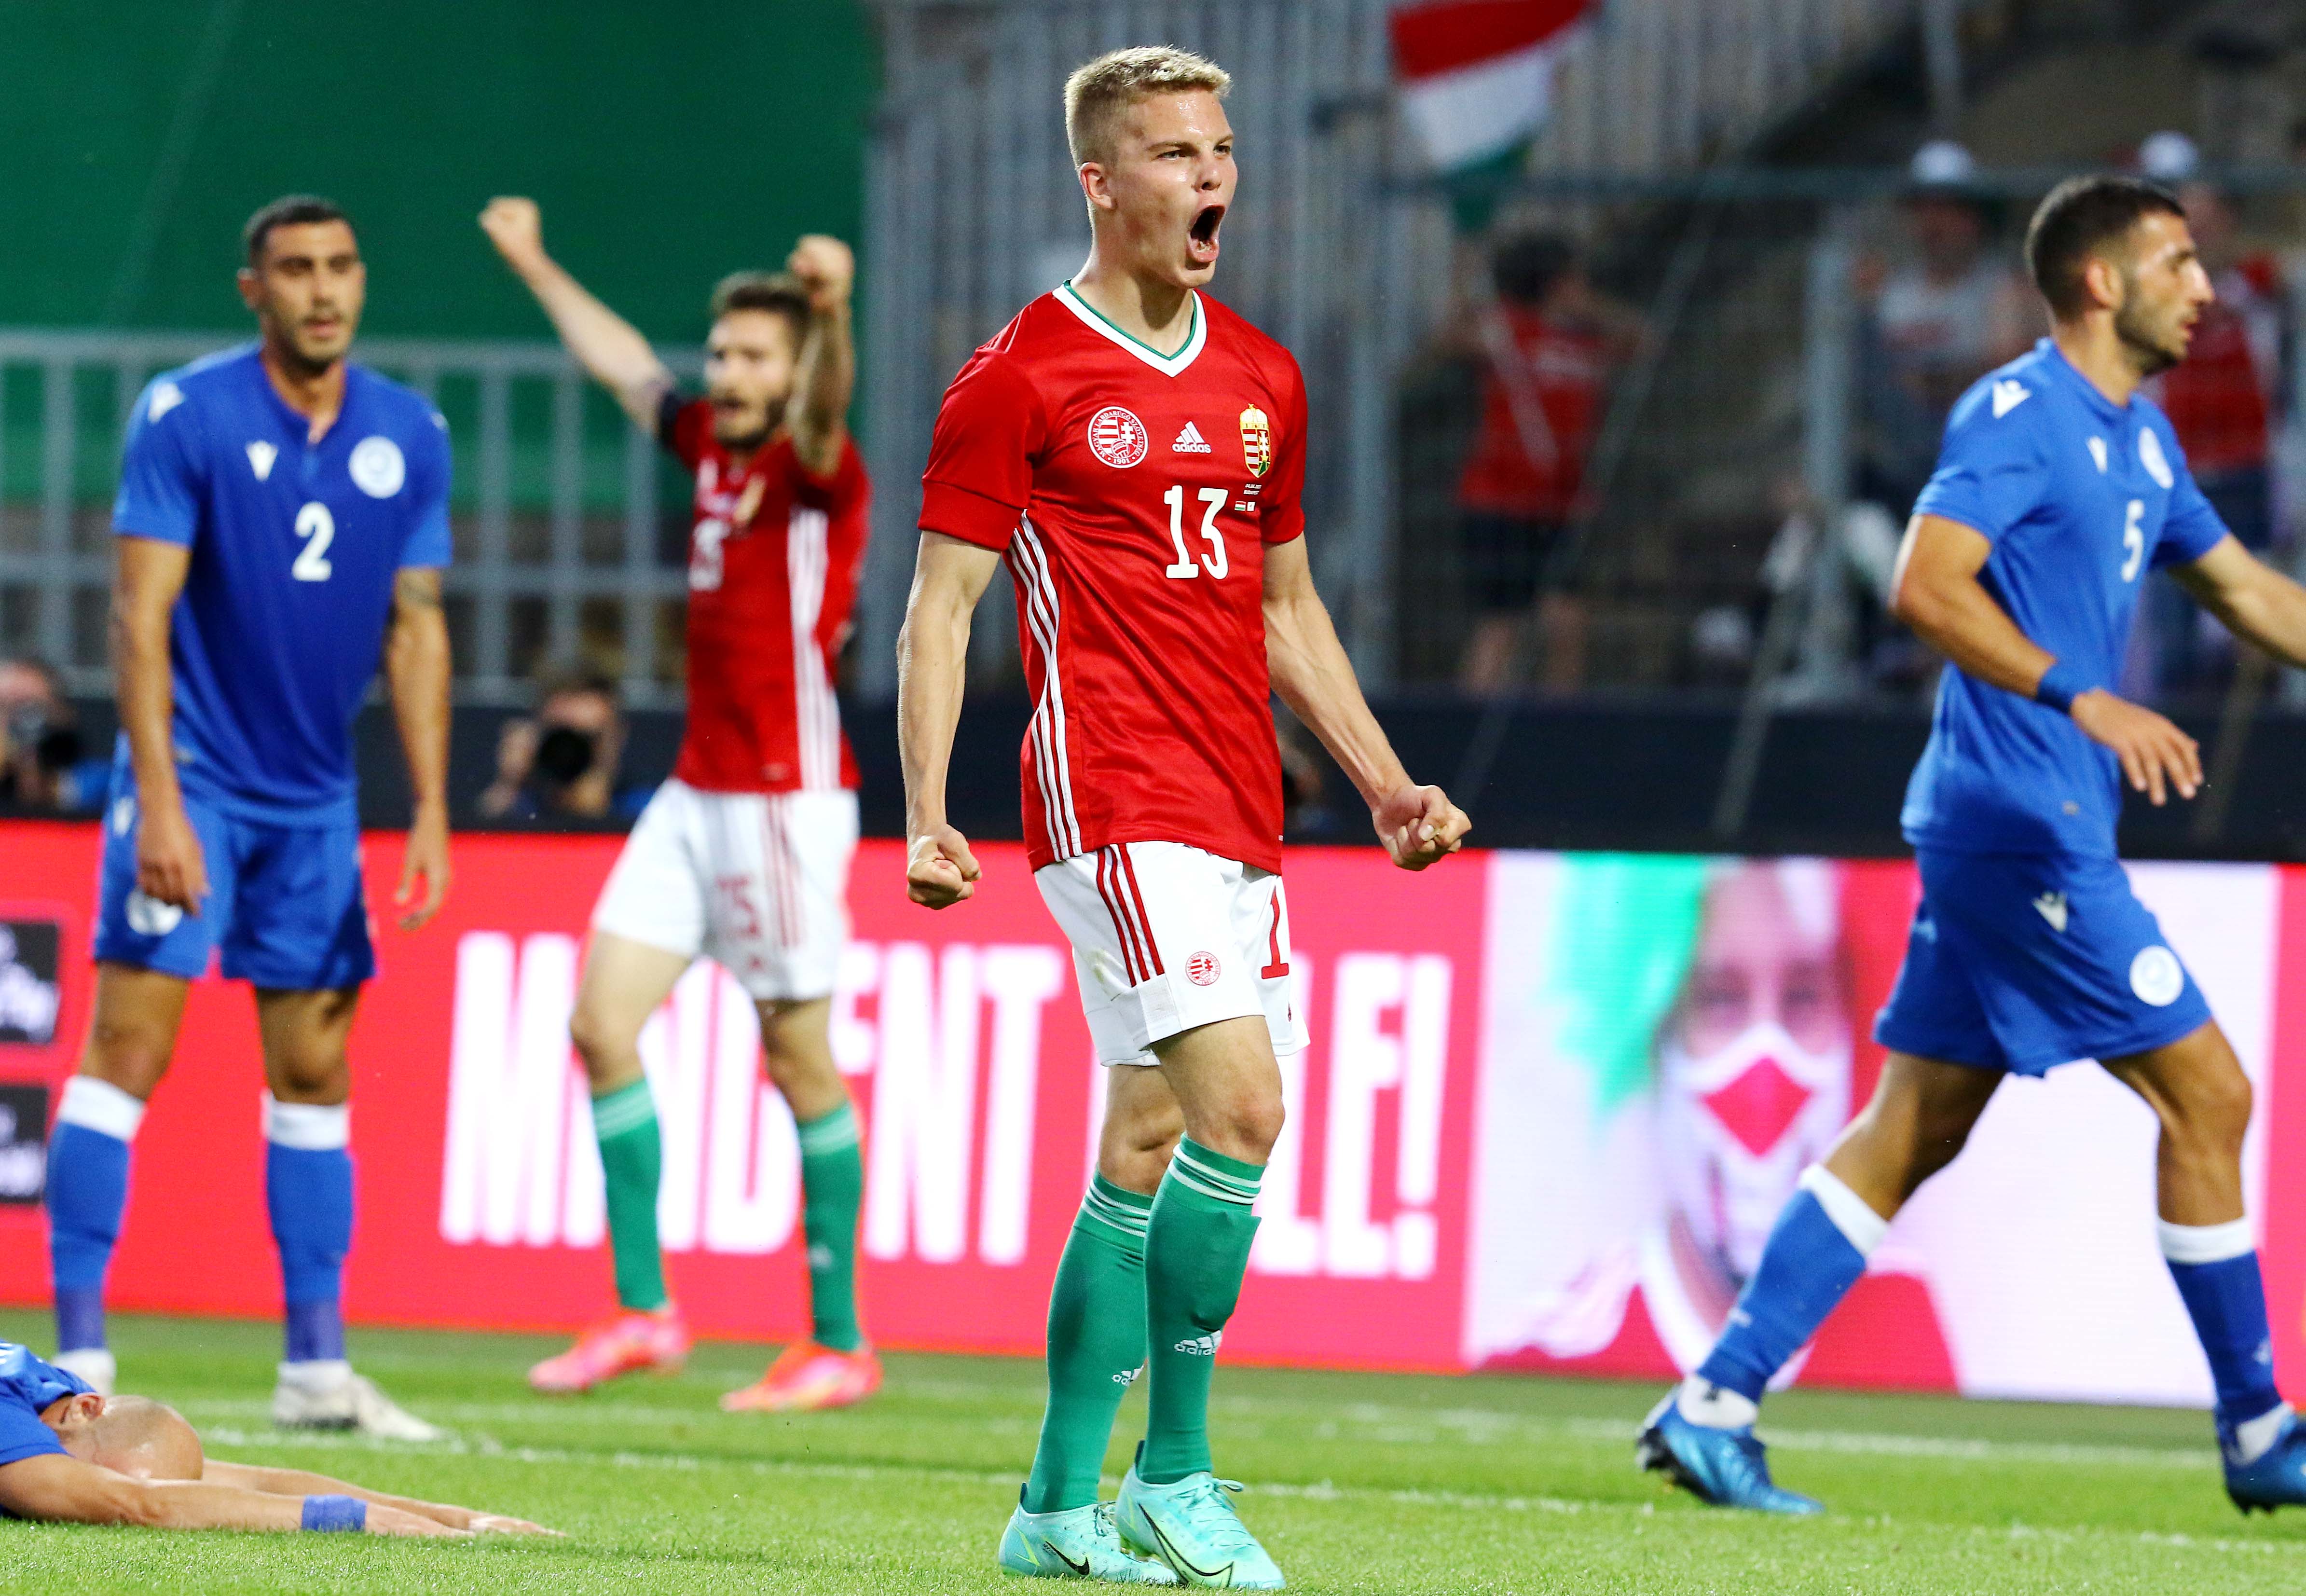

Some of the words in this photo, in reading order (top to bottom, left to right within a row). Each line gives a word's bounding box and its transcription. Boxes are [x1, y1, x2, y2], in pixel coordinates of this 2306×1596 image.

[1171, 443, 1212, 454] adidas
[291, 501, 335, 582] 2
[1164, 485, 1229, 579] 13
[2121, 499, 2144, 583] 5
